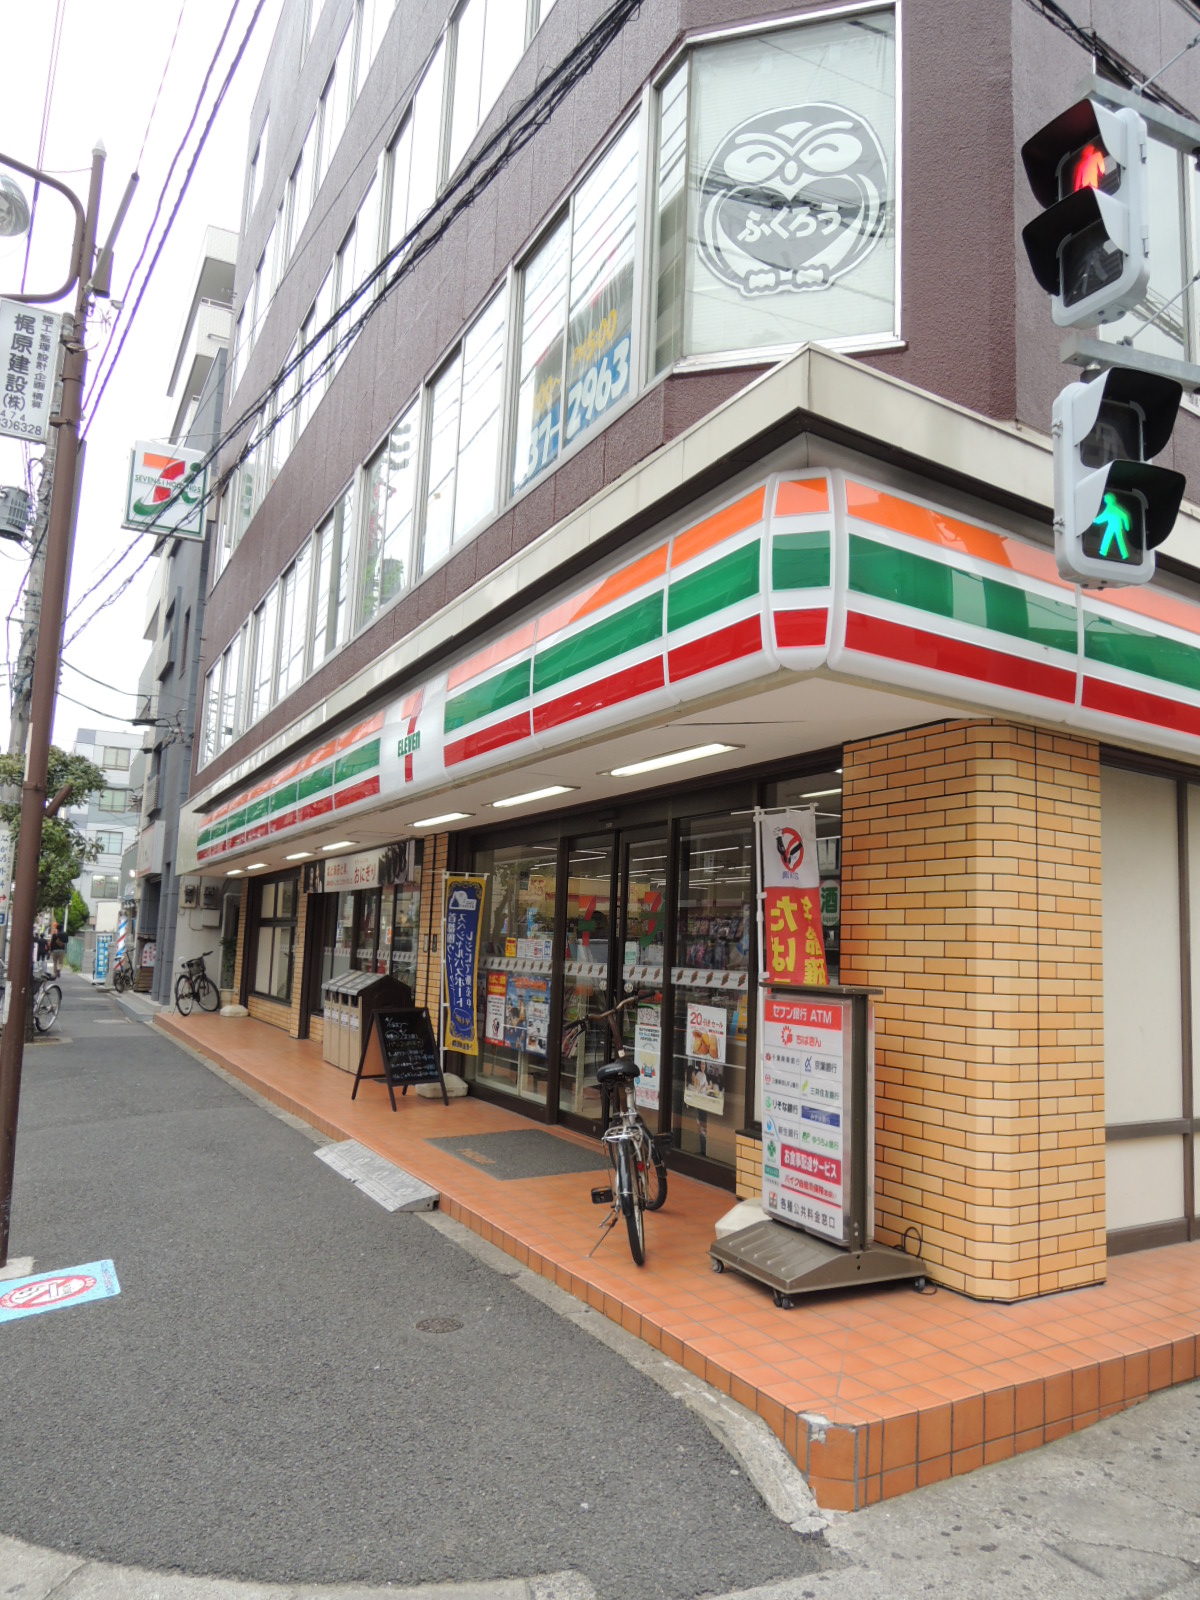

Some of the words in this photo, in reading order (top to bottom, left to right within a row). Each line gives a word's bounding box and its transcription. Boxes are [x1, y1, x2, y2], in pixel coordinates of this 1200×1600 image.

[736, 202, 842, 243] ふくろう
[354, 863, 377, 884] おにぎり
[820, 887, 838, 914] 酒
[773, 1004, 807, 1021] セブン銀行
[810, 1009, 832, 1024] ATM
[814, 1060, 837, 1073] 京葉銀行
[810, 1087, 840, 1101] 三井住友銀行
[772, 1099, 798, 1115] りそな銀行
[778, 1125, 798, 1140] 新生銀行
[812, 1136, 839, 1151] ゆうちょ銀行
[784, 1149, 837, 1179] お食事配達サービス
[780, 1197, 835, 1229] 各種公共料金窓口
